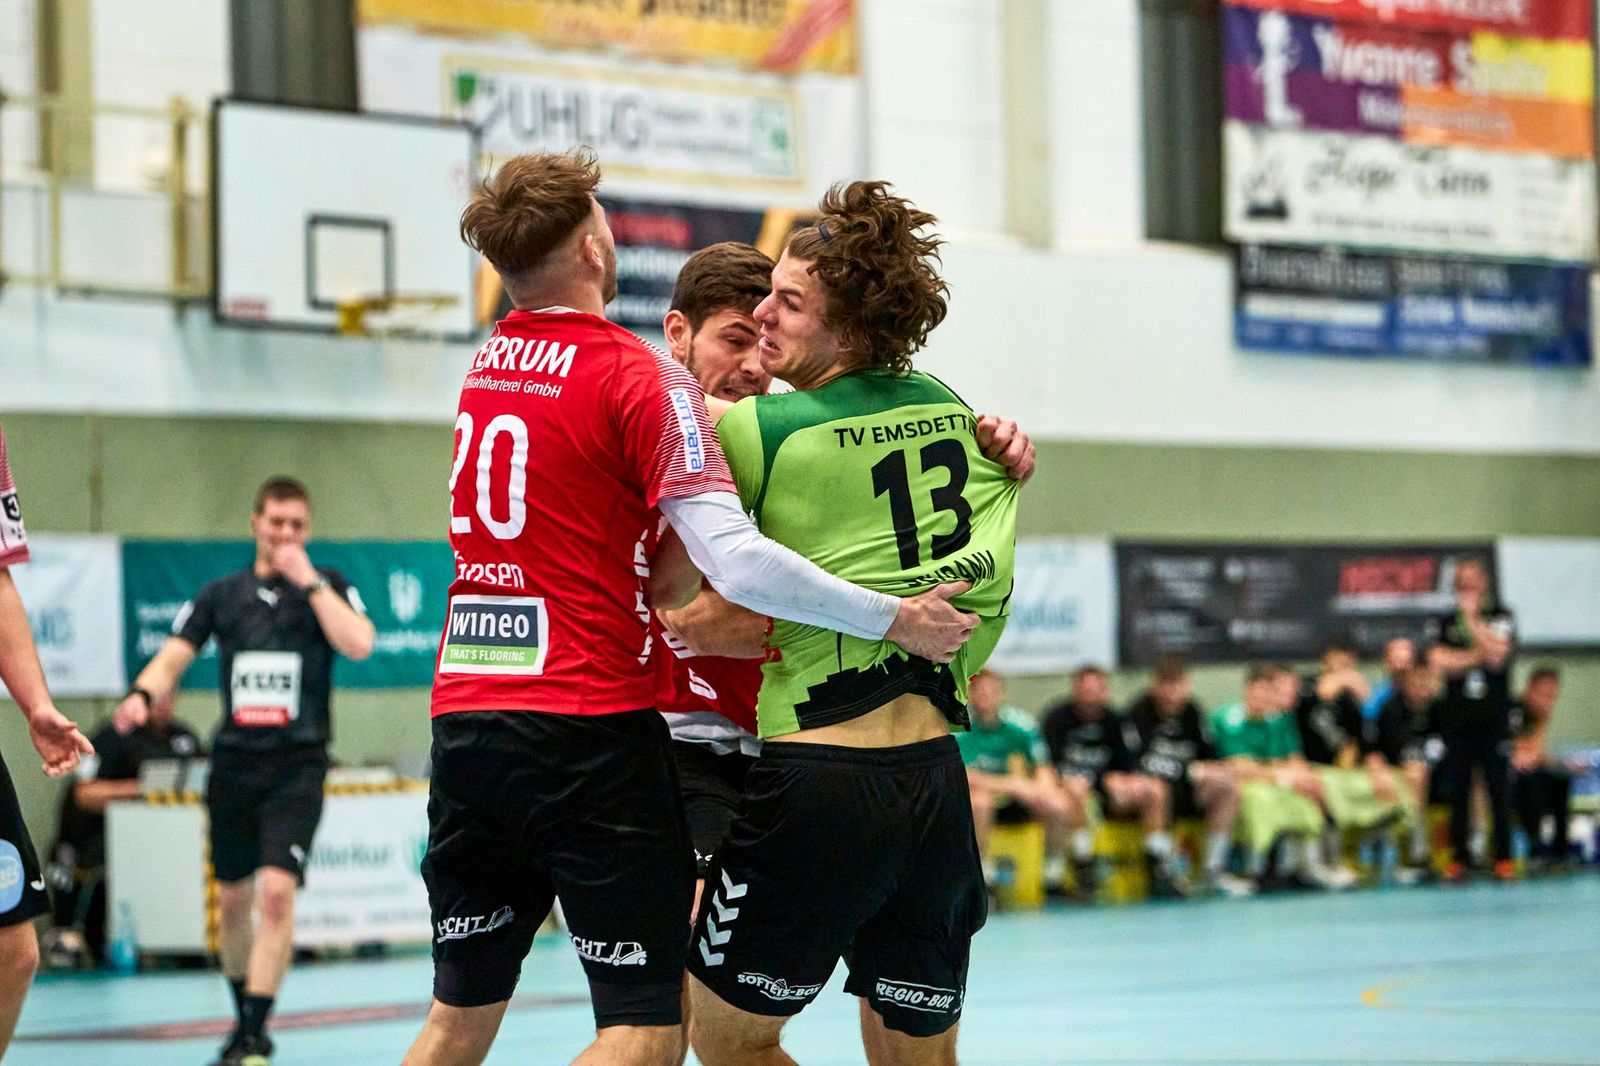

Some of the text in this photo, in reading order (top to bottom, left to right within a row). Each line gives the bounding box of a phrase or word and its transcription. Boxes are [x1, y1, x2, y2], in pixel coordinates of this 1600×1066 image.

[470, 336, 578, 378] ERRUM
[523, 379, 563, 399] GmbH
[834, 427, 865, 448] TV
[449, 411, 528, 539] 20
[871, 438, 973, 571] 13
[450, 648, 525, 662] THAT'S FLOORING
[875, 982, 955, 1009] REGIO-BOX
